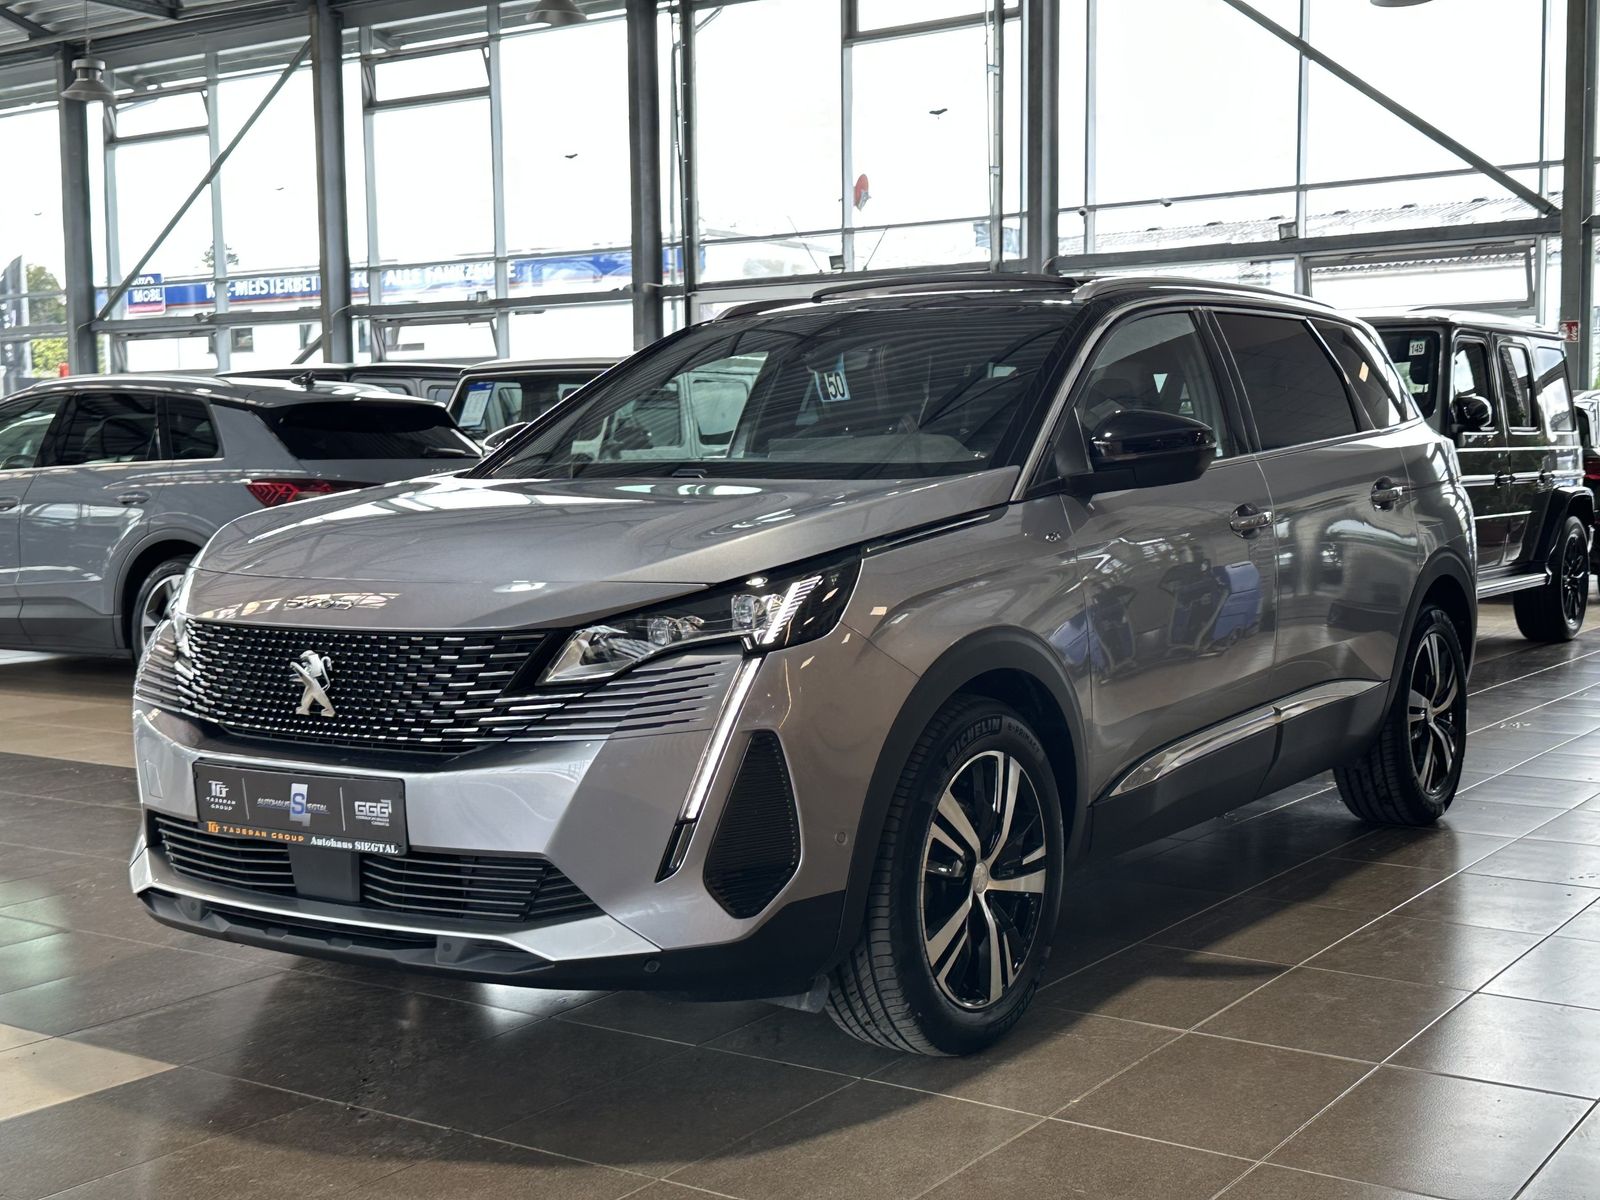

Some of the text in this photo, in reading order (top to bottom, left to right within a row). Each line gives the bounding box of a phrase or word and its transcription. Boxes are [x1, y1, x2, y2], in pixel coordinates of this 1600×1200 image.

[271, 832, 305, 842] GROUP
[310, 835, 399, 855] Autohaus SIEGTAL
